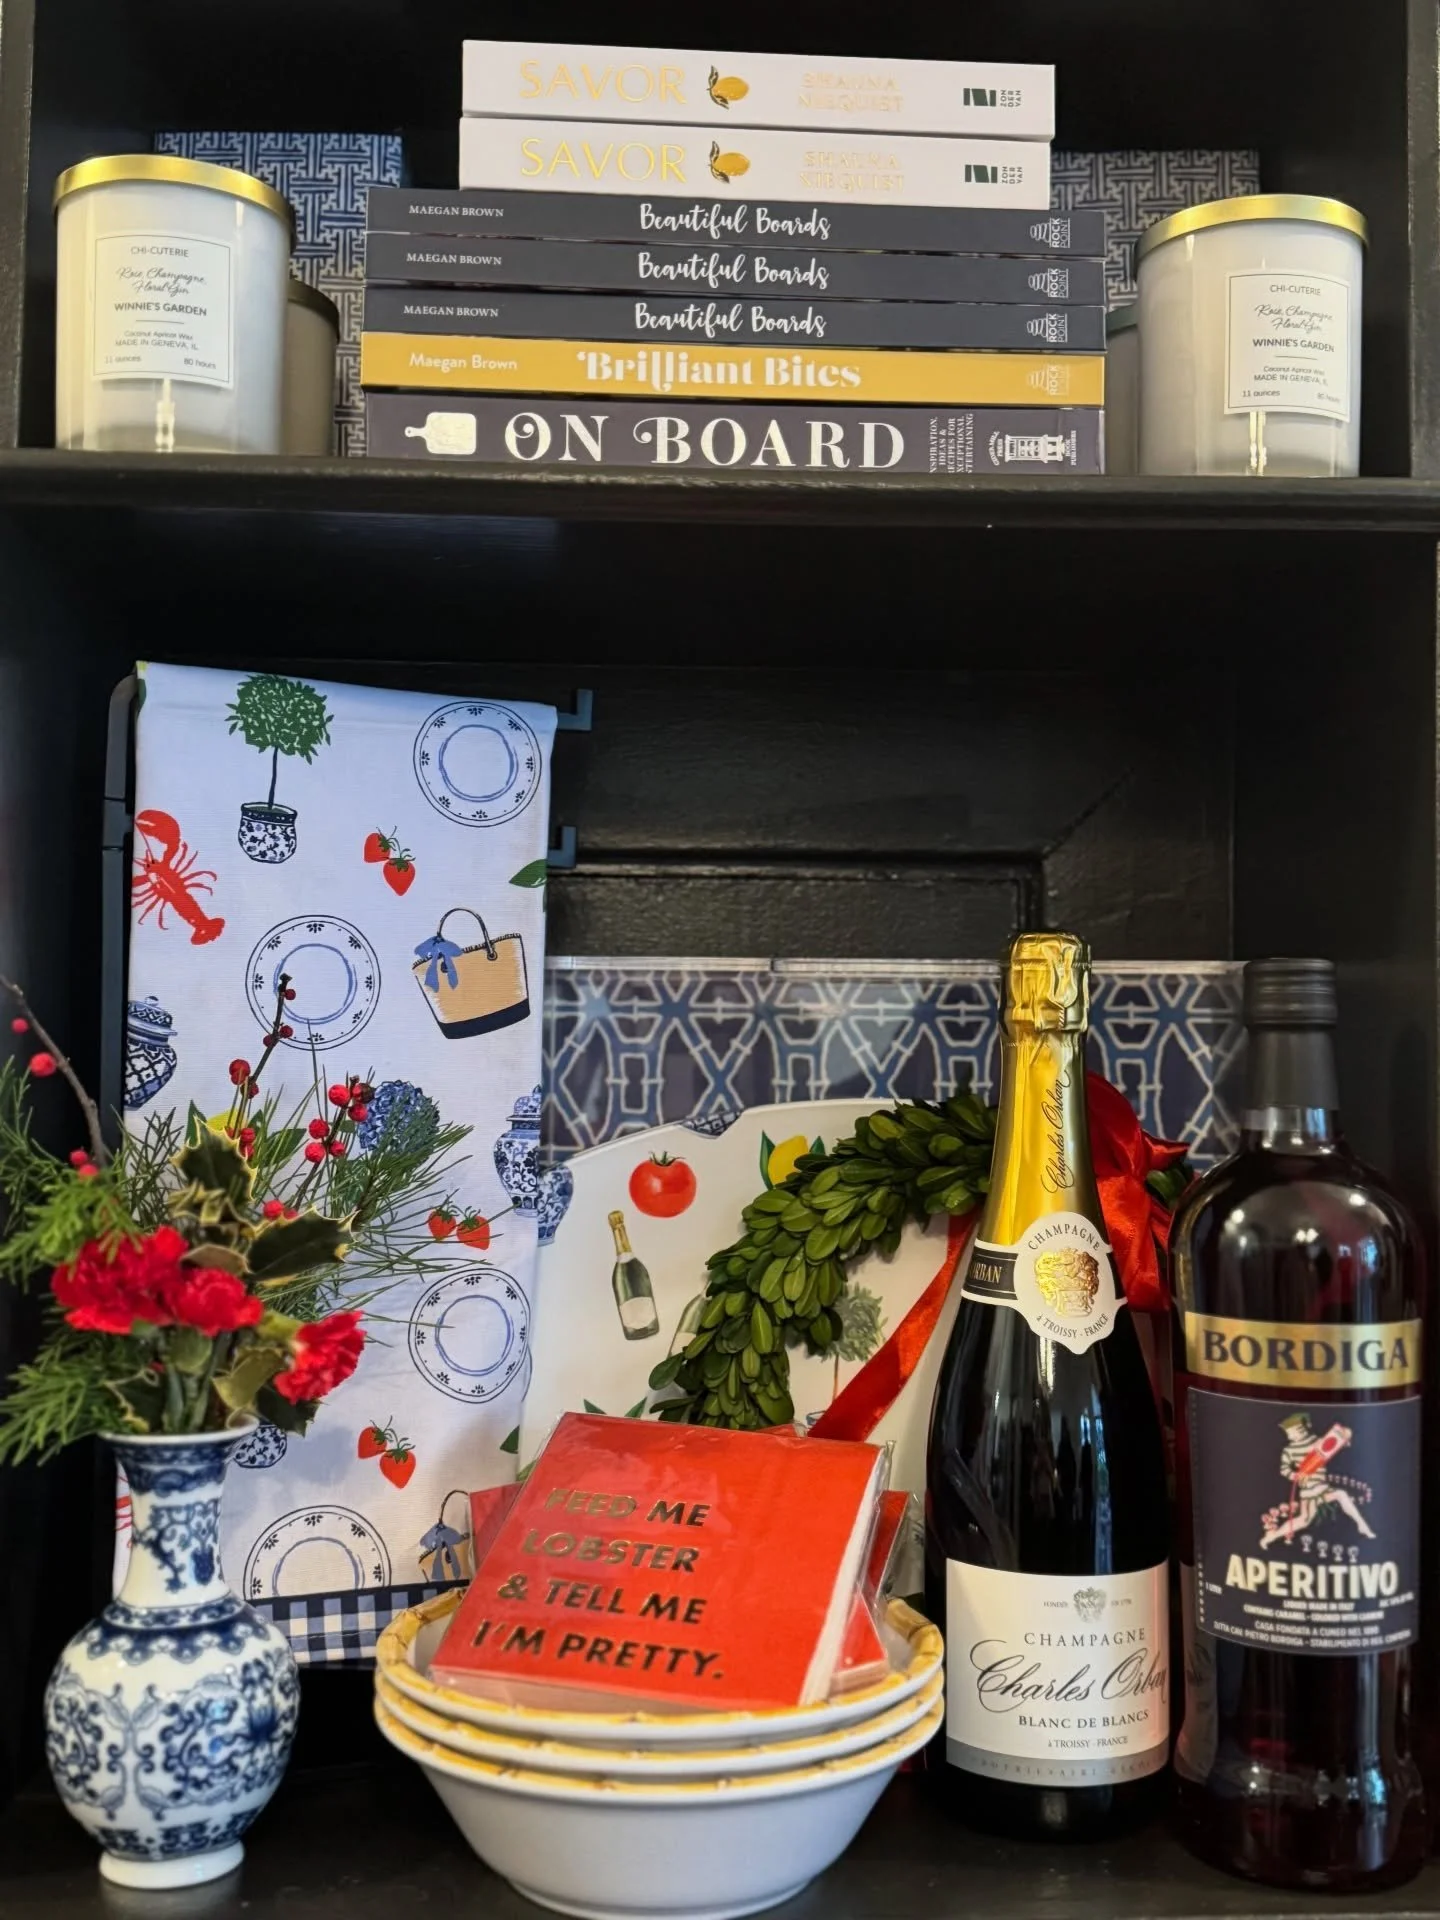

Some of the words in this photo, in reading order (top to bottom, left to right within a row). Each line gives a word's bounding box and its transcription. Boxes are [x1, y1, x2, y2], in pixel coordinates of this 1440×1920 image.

[519, 60, 687, 104] SAVOR
[521, 137, 687, 183] SAVOR
[408, 205, 460, 216] MAEGAN
[461, 207, 504, 217] BROWN
[640, 203, 748, 239] Beautiful
[756, 207, 831, 240] Boards
[1052, 218, 1061, 248] ROCK
[1060, 218, 1068, 248] POINT
[131, 246, 189, 257] CHI-CUTERIE
[406, 252, 457, 264] MAEGAN
[459, 255, 502, 265] BROWN
[638, 252, 746, 289] Beautiful
[754, 256, 830, 290] Boards
[1050, 268, 1059, 298] ROCK
[1058, 268, 1067, 298] POINT
[132, 280, 167, 293] Floral
[1269, 284, 1321, 296] CHI-CUTERIE
[114, 302, 160, 311] WINNIE'S
[163, 303, 207, 316] GARDEN
[403, 305, 454, 316] MAEGAN
[456, 307, 499, 317] BROWN
[635, 302, 743, 339] Beautiful
[751, 306, 827, 338] Boards
[1048, 313, 1057, 343] ROCK
[1057, 313, 1065, 343] POINT
[1271, 318, 1303, 331] Floral
[1252, 338, 1298, 348] WINNIE'S
[1300, 339, 1335, 352] GARDEN
[196, 359, 216, 370] hours
[409, 352, 467, 374] Maegan
[471, 354, 518, 371] Brown
[576, 349, 753, 393] Brilliant
[764, 355, 861, 388] Bites
[1242, 390, 1251, 398] 11
[504, 411, 610, 462] ON
[633, 415, 905, 469] BOARD
[948, 418, 956, 437] FOR
[929, 417, 938, 473] NSPIRATION,
[957, 416, 965, 473] XCEPTIONAL
[1041, 1069, 1072, 1130] Orban
[1041, 1132, 1075, 1193] Charles
[1027, 1223, 1100, 1252] CHAMPAGNE
[1043, 1317, 1078, 1338] TROISSY
[1084, 1313, 1109, 1337] FRANCE
[1203, 1329, 1410, 1372] BORDIGA
[544, 1487, 638, 1519] FEED
[646, 1499, 712, 1528] ME
[521, 1528, 701, 1573] LOBSTER
[1225, 1553, 1399, 1599] APERITIVO
[498, 1573, 528, 1601] &
[546, 1578, 625, 1615] TELL
[639, 1593, 708, 1626] ME
[1024, 1628, 1146, 1647] CHAMPAGNE
[1254, 1620, 1274, 1632] CASA
[471, 1619, 548, 1655] I'M
[558, 1632, 724, 1680] PRETTY.
[970, 1639, 1096, 1713] Charles
[1019, 1715, 1071, 1729] BLANC
[1077, 1717, 1097, 1728] DE
[1102, 1709, 1149, 1727] BLANCS
[1053, 1739, 1091, 1749] TROISSY
[1097, 1736, 1129, 1748] FRANCE
